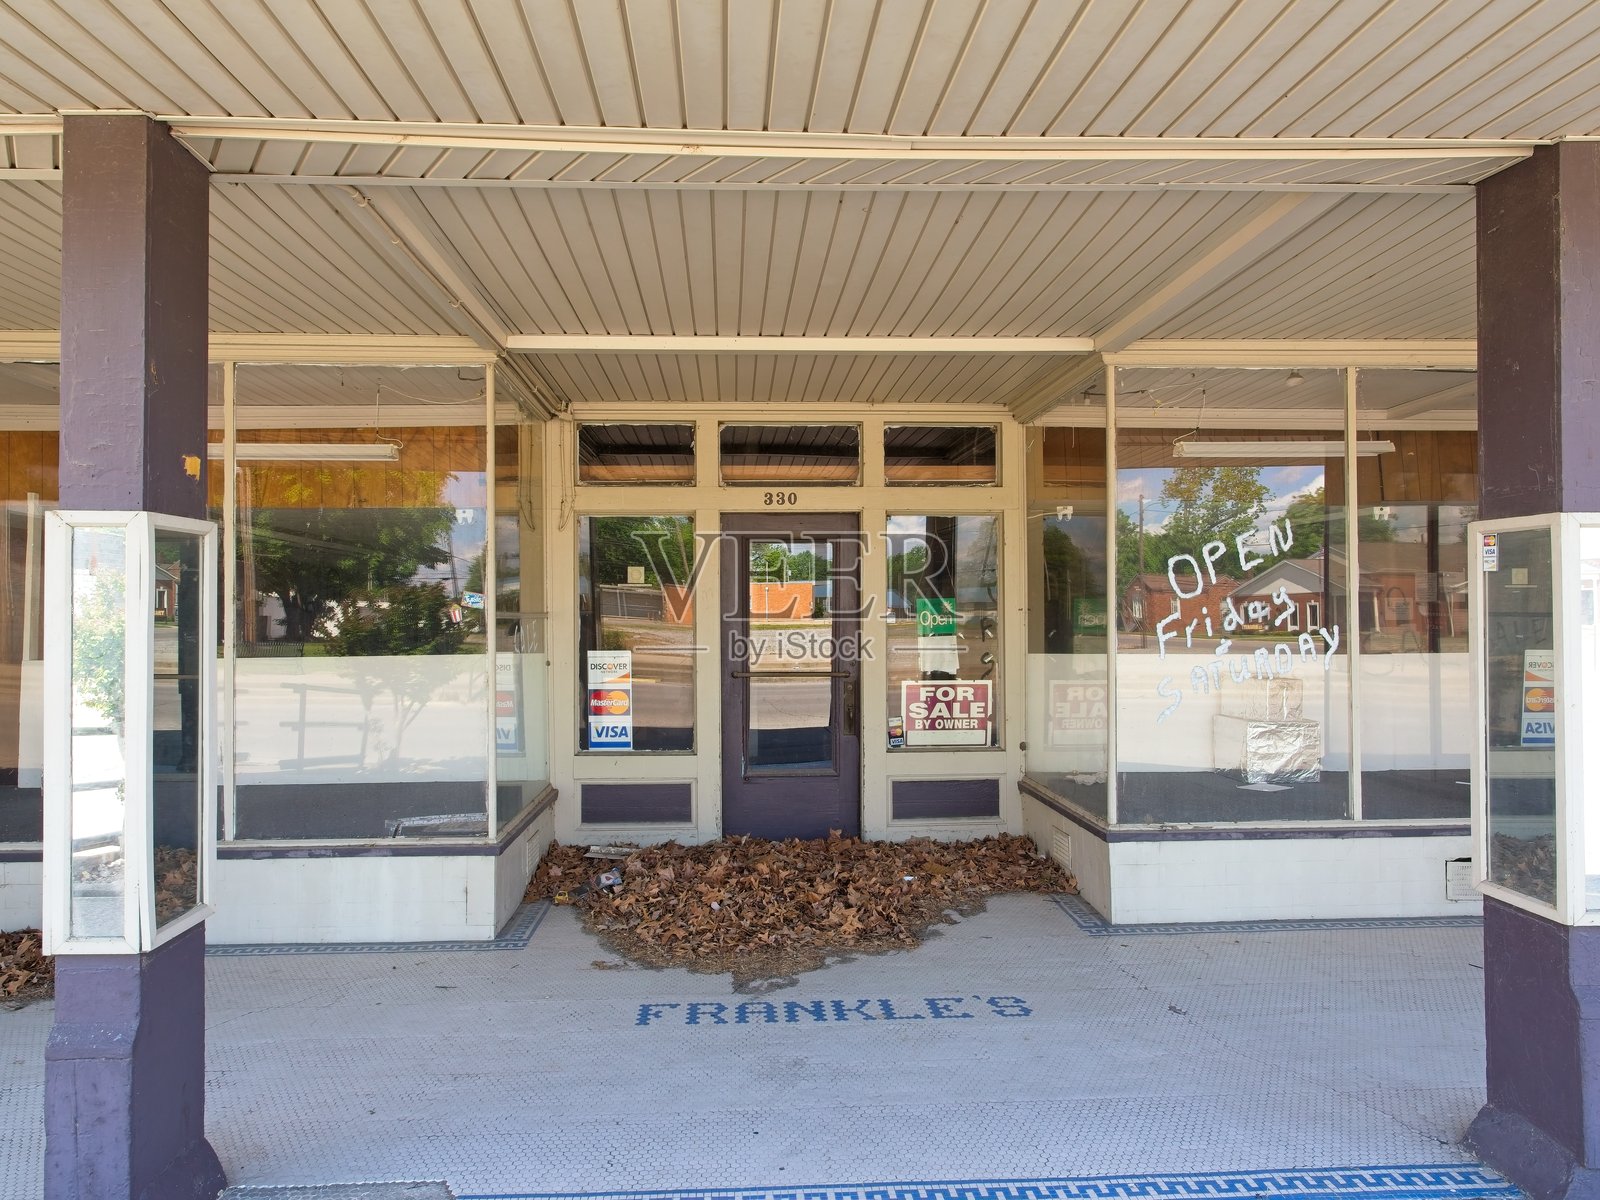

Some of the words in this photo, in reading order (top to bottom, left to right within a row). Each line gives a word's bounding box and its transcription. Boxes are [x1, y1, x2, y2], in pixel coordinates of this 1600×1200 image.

[763, 492, 797, 505] 330
[1167, 518, 1293, 598] OPEN
[920, 610, 952, 627] Open
[1156, 586, 1295, 659] Friday
[590, 663, 627, 671] DISCOVER
[919, 686, 974, 701] FOR
[590, 699, 629, 707] MasterCard
[908, 702, 985, 718] SALE
[595, 726, 628, 737] VISA
[915, 720, 931, 729] BY
[935, 719, 978, 728] OWNER
[634, 995, 1033, 1026] FRANKLE'S
